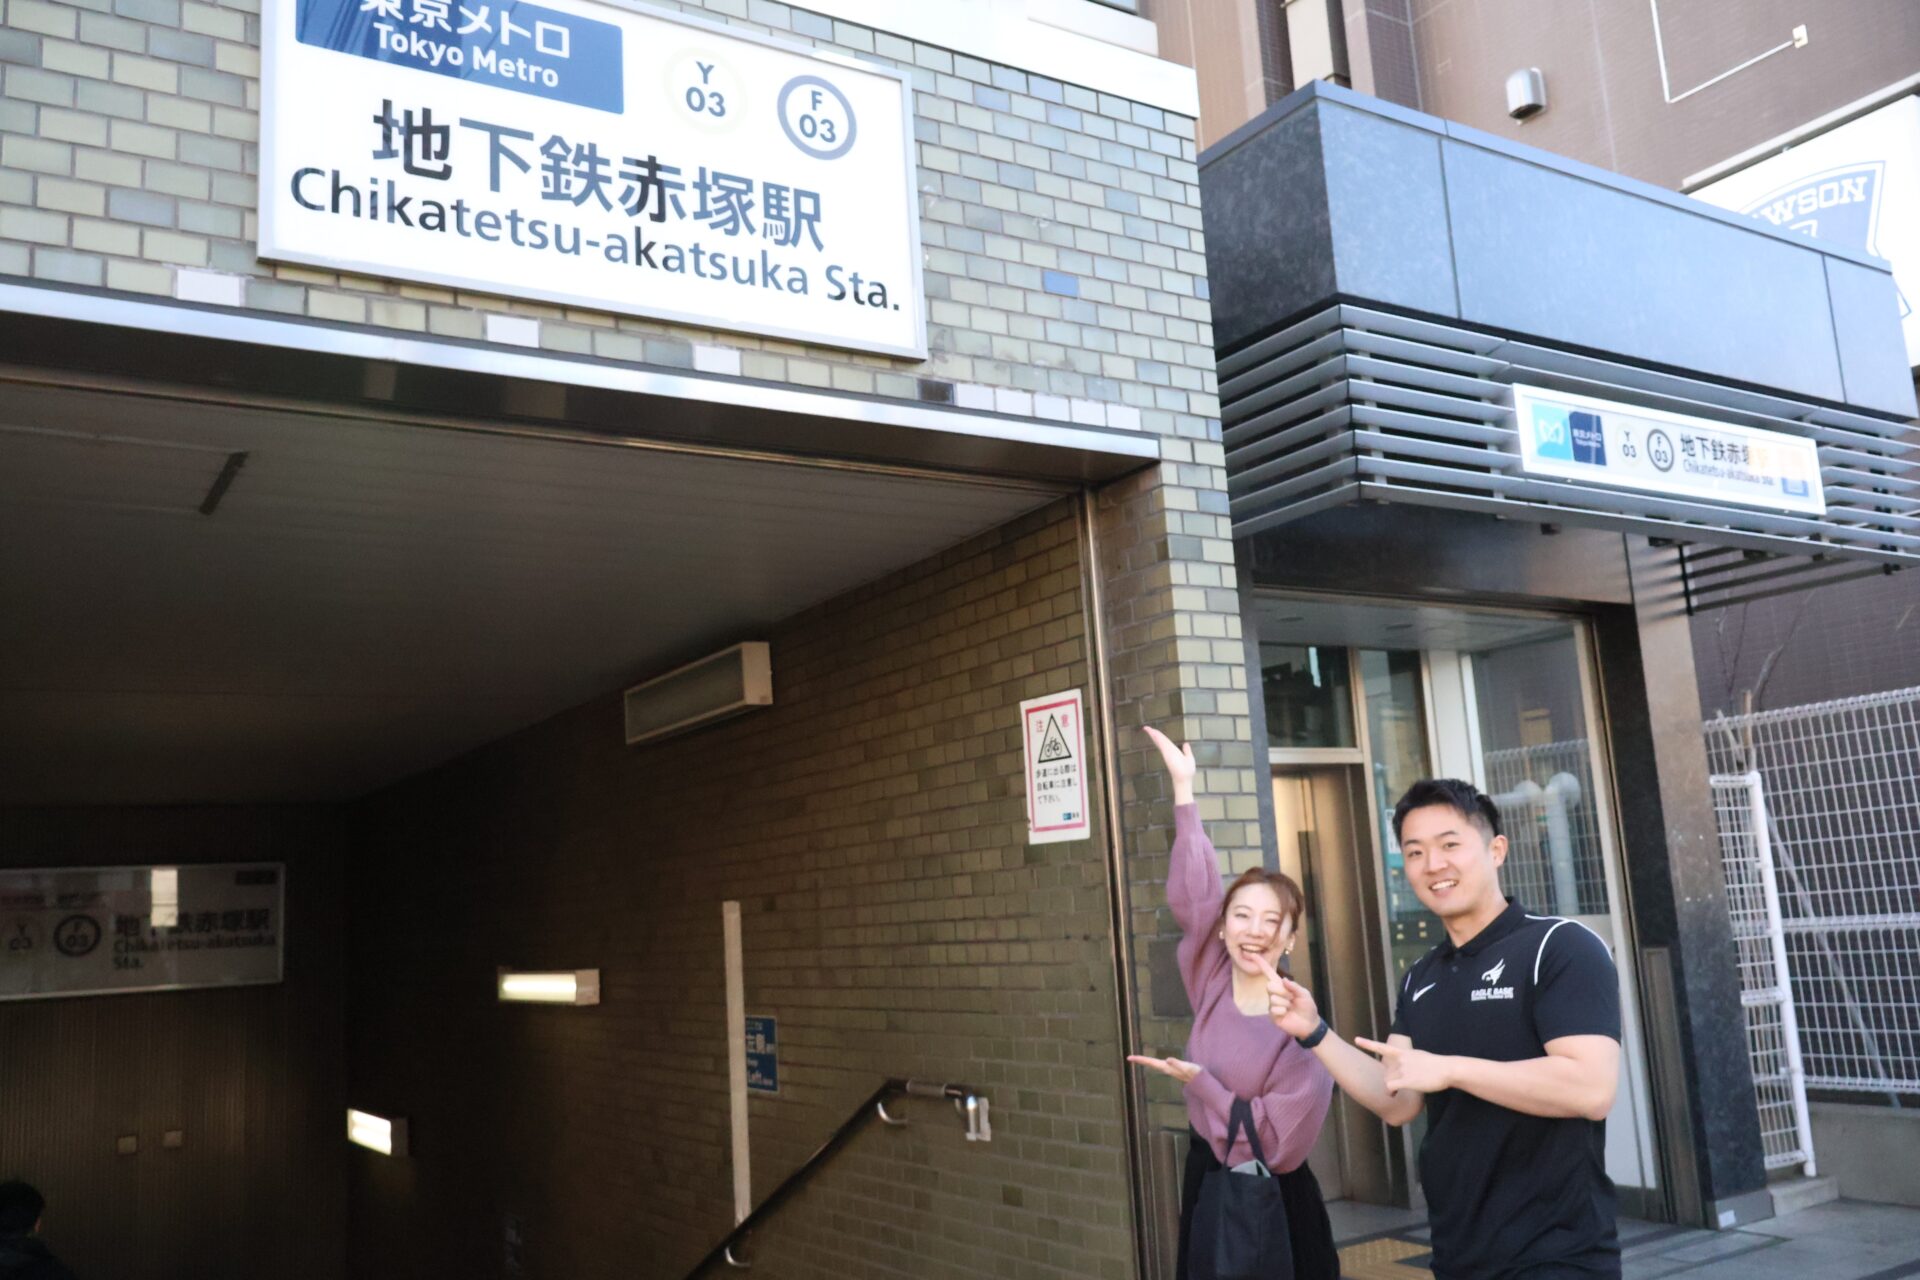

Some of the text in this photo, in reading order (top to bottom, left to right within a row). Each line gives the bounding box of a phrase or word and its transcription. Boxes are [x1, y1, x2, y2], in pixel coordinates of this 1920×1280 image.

[373, 21, 560, 89] Tokyo Metro
[695, 61, 715, 85] Y
[685, 87, 727, 118] 03
[810, 91, 823, 110] F
[799, 112, 838, 144] 03
[372, 98, 826, 253] 地下鉄赤塚駅
[1752, 176, 1868, 225] WSON
[290, 166, 902, 312] Chikatetsu-akatsuka Sta.
[1622, 444, 1637, 458] 03
[1624, 430, 1631, 441] Y
[1654, 449, 1669, 463] 03
